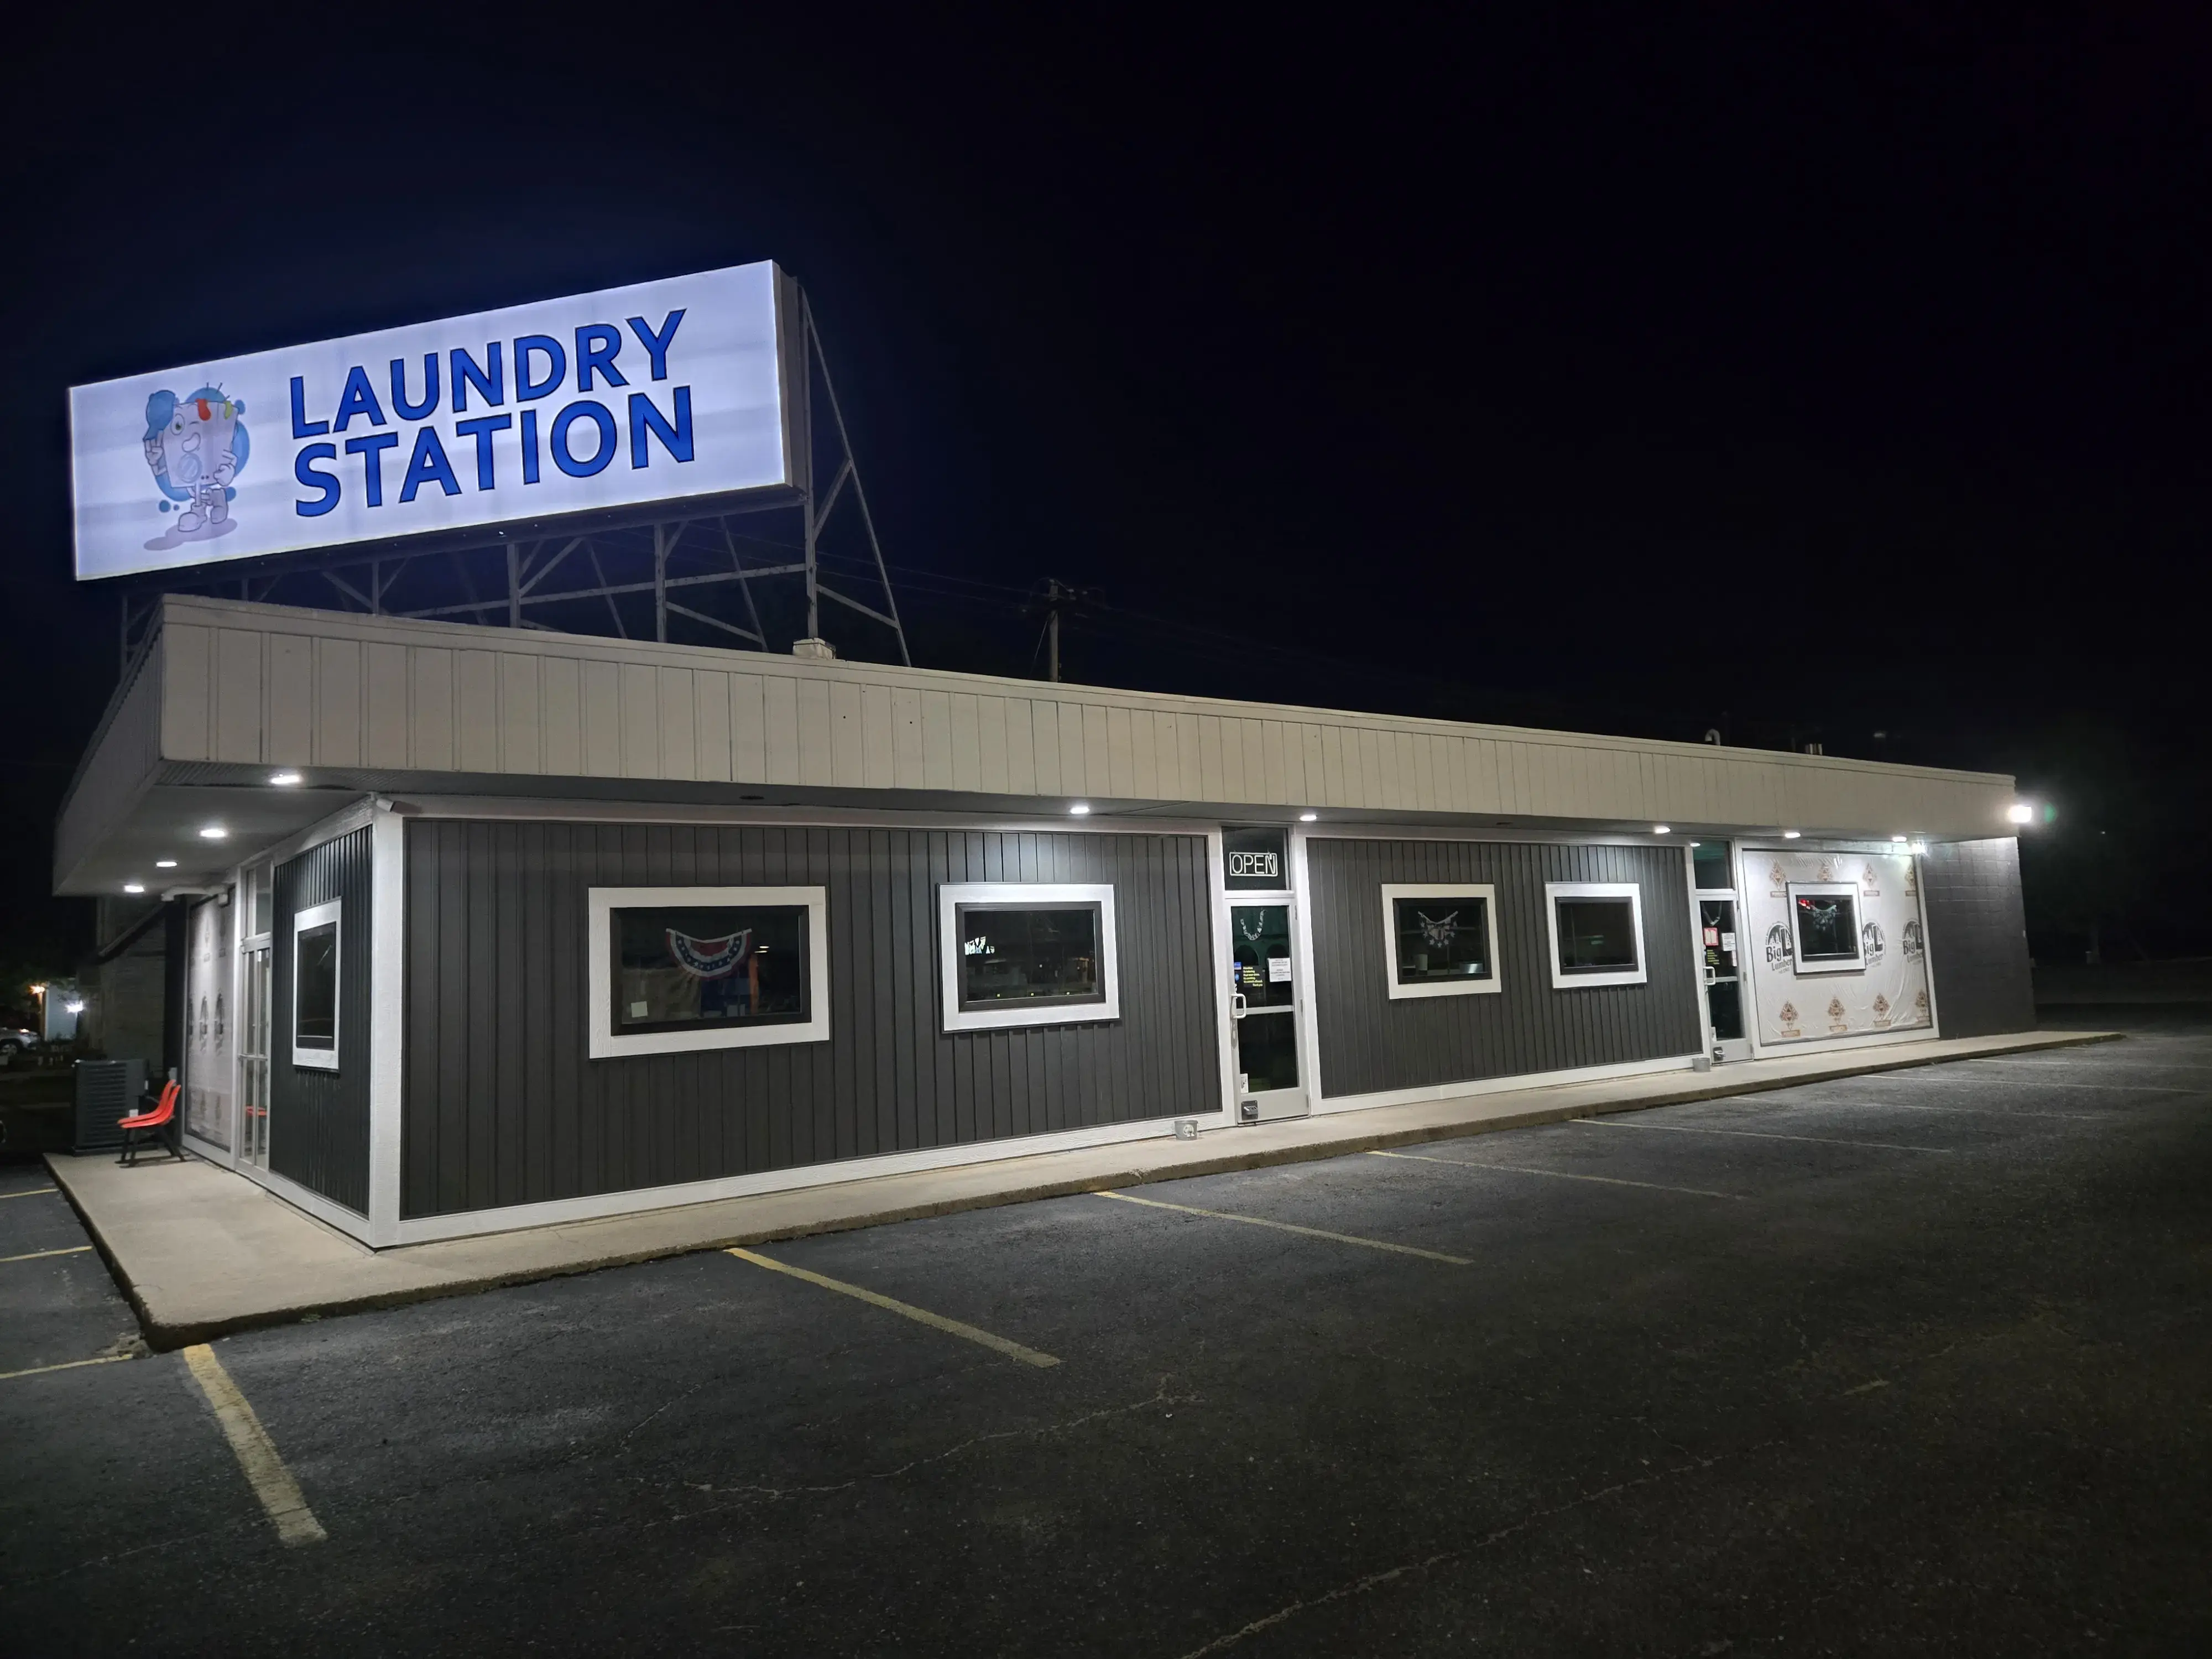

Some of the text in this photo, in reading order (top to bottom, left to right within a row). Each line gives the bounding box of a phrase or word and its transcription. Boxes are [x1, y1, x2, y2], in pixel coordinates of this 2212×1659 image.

[289, 308, 686, 440] LAUNDRY
[294, 385, 695, 518] STATION
[1232, 854, 1276, 874] OPEN
[1766, 946, 1781, 962] Big
[1903, 940, 1915, 954] Big
[1771, 958, 1792, 971] Lumber
